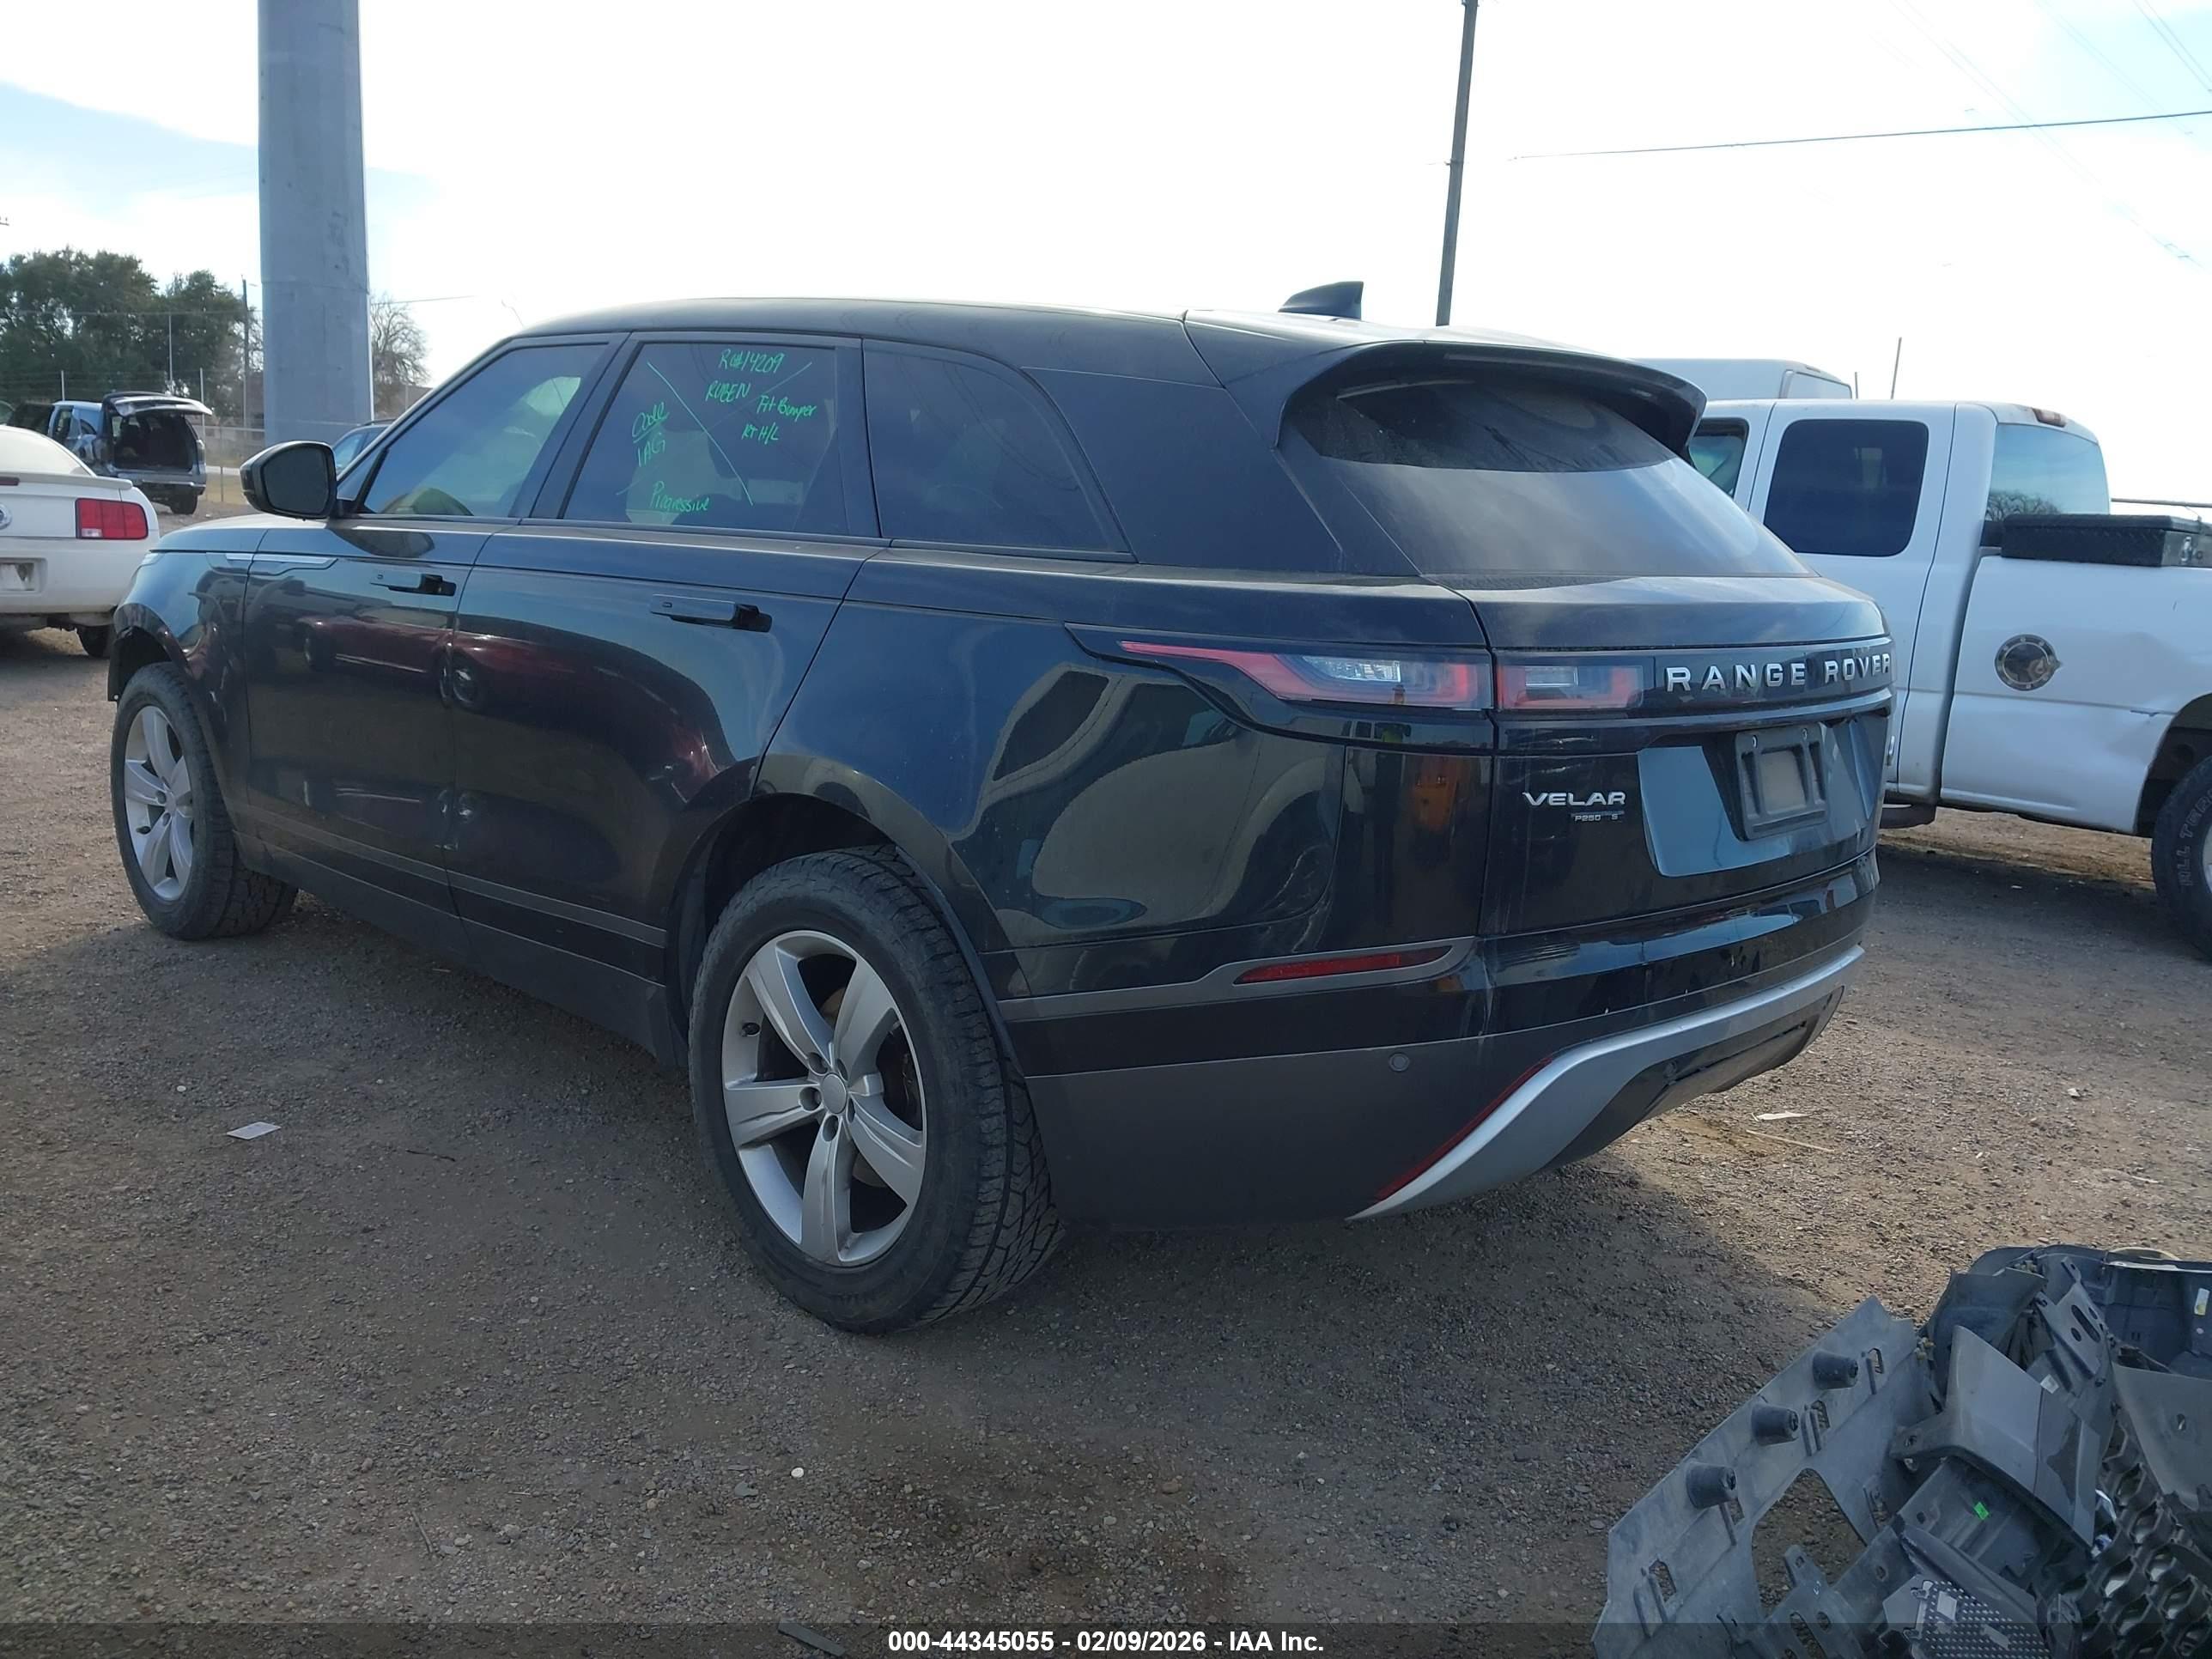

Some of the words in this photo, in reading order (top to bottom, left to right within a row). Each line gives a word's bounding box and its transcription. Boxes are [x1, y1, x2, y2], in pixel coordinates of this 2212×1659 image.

[705, 380, 751, 403] RUBEN
[1664, 663, 1806, 692] RANGE
[1823, 653, 1890, 684] ROVER
[1522, 791, 1626, 806] VELAR
[1574, 813, 1602, 823] P250
